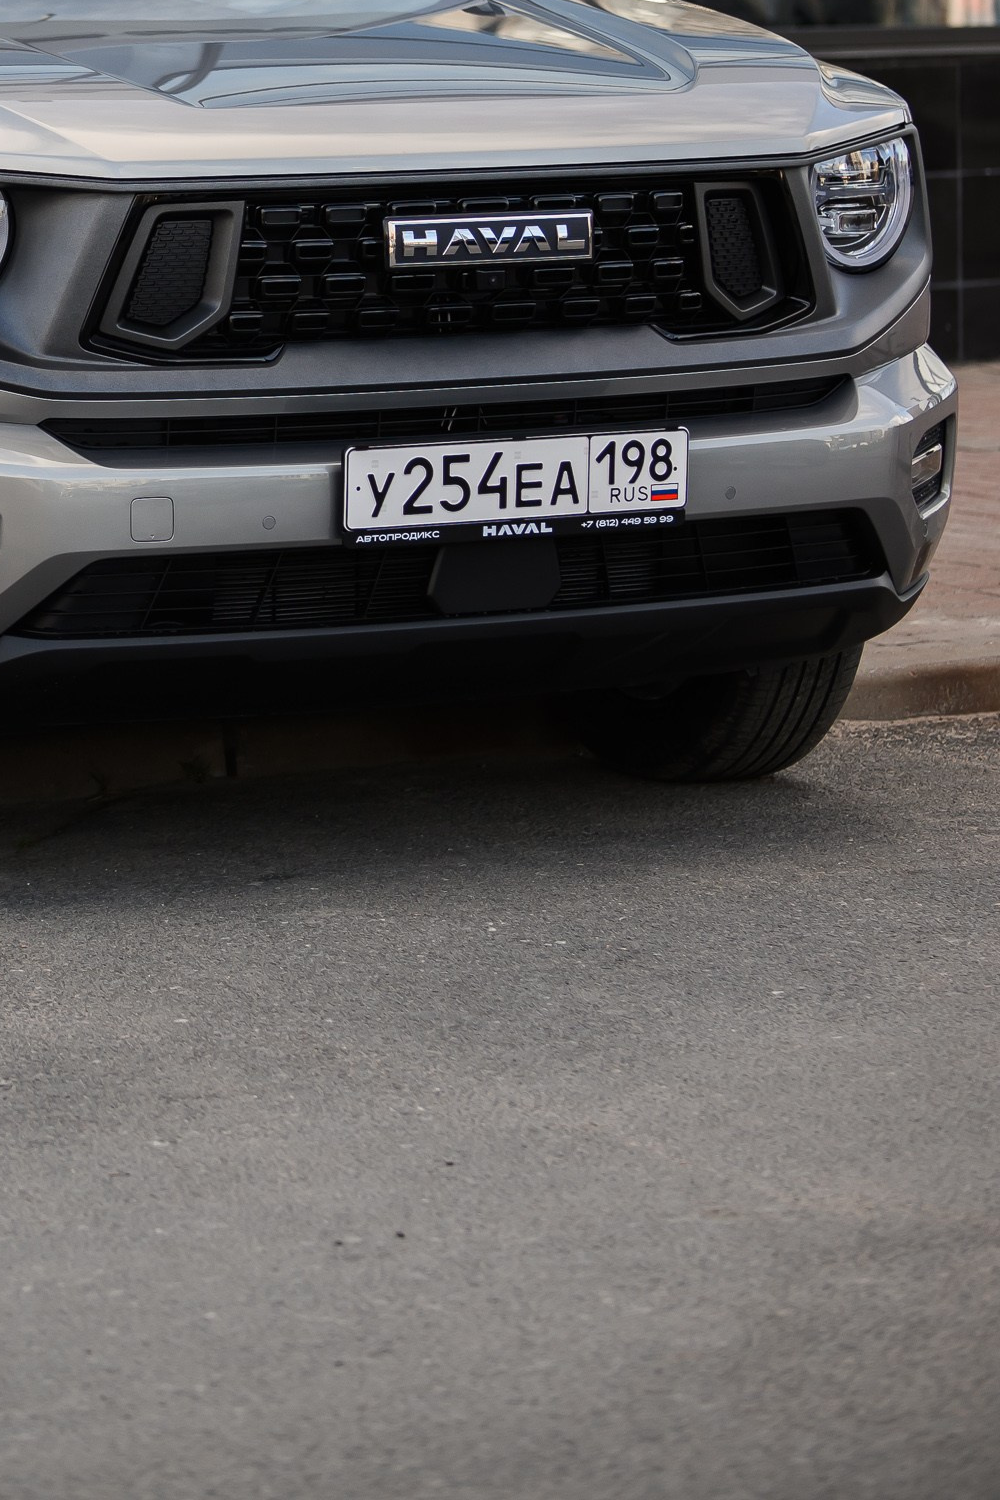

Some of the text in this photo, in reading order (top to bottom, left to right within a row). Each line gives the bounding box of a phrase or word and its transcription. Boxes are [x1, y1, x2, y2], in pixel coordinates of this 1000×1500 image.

[401, 223, 586, 257] HAVAL
[595, 438, 673, 485] 198
[609, 485, 649, 504] RUS
[482, 522, 553, 537] HAVAL
[580, 515, 674, 529] +7 (812) 449 59 99
[355, 530, 440, 544] АВТОПРОДИКС
